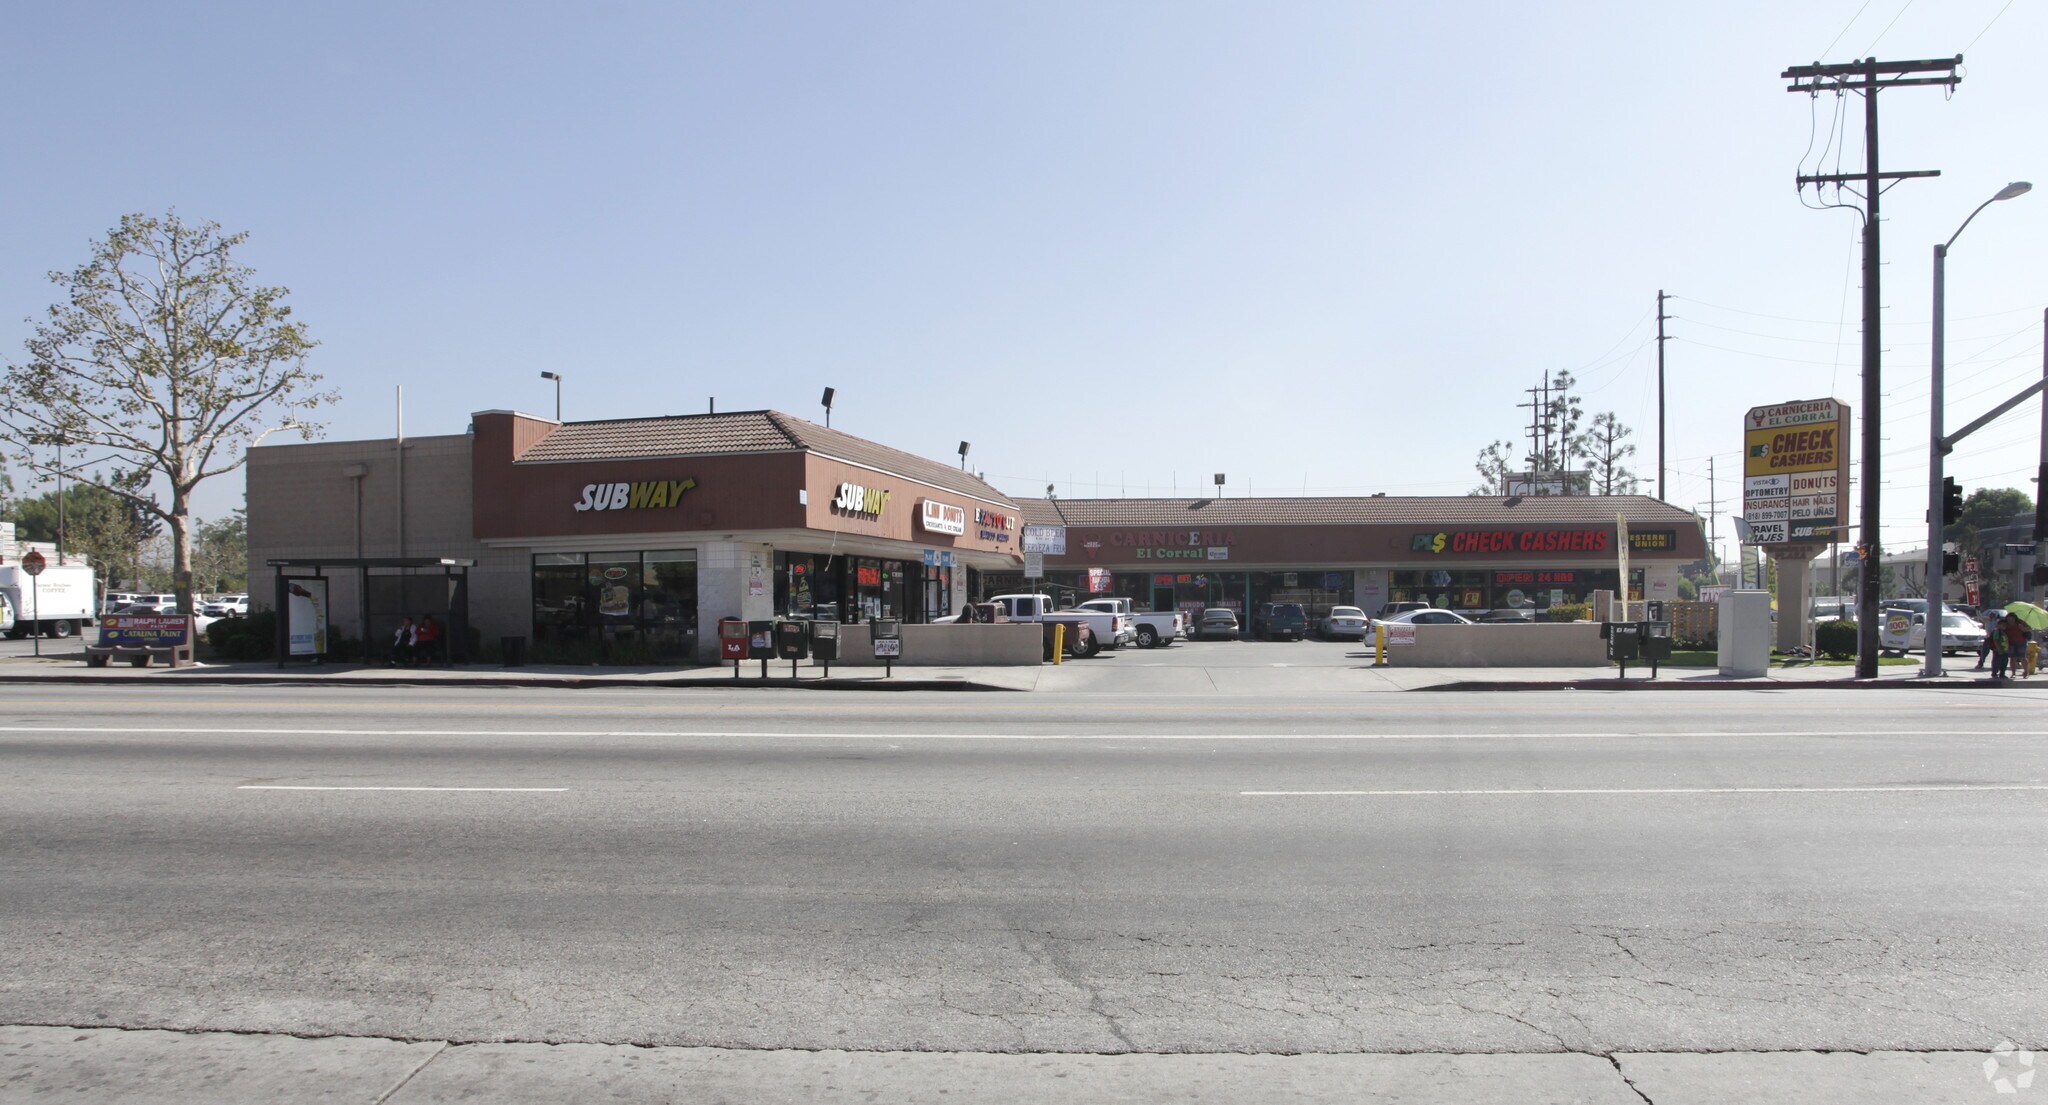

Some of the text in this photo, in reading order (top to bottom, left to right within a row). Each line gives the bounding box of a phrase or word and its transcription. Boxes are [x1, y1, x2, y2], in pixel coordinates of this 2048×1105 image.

[1768, 401, 1832, 417] CARNICERIA
[1769, 411, 1833, 426] EL CORRAL
[1772, 428, 1835, 454] CHECK
[1770, 451, 1833, 468] CASHERS
[1793, 476, 1836, 490] DONUTS
[574, 477, 696, 512] SUBWAY
[1746, 487, 1789, 497] OPTOMETRY
[836, 482, 891, 516] SUBWAY
[1745, 498, 1790, 510] INSURANCE
[1792, 496, 1836, 507] HAIR NAILS
[943, 505, 963, 524] DONUTS
[1792, 506, 1834, 518] PELO UÑAS
[1025, 527, 1064, 538] COLD BEER
[1791, 525, 1832, 537] SUBAY
[1109, 531, 1238, 546] CARNICERIA
[1453, 531, 1516, 552] CHECK
[1520, 531, 1608, 551] CASHERS
[1753, 533, 1784, 542] IAJES
[1136, 548, 1203, 558] El Corral
[1089, 568, 1111, 576] SPECIAL
[1496, 572, 1534, 583] OPEN
[1538, 572, 1552, 582] 24
[122, 629, 157, 637] CATALINA
